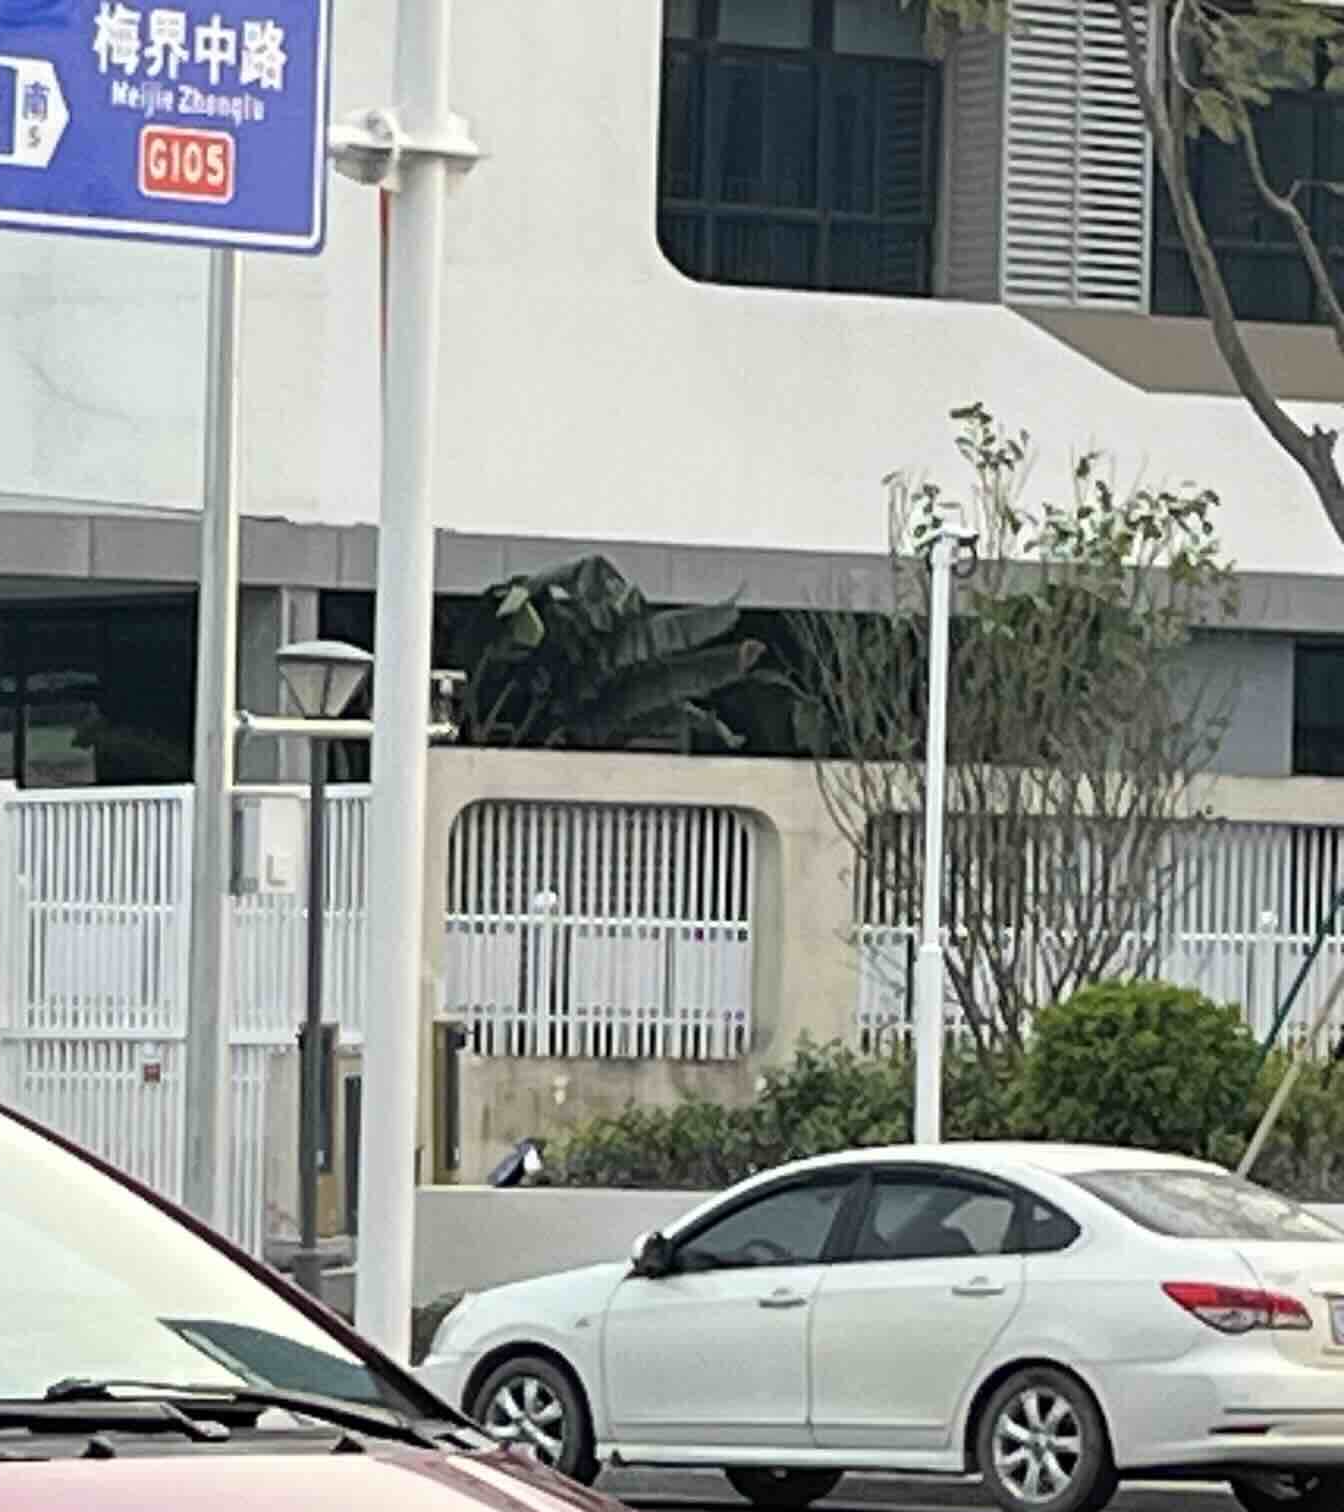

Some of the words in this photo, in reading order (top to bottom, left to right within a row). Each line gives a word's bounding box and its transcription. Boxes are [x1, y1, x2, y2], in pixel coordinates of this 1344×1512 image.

[94, 1, 288, 91] 梅界中路
[23, 81, 50, 122] 南
[149, 138, 225, 186] G105
